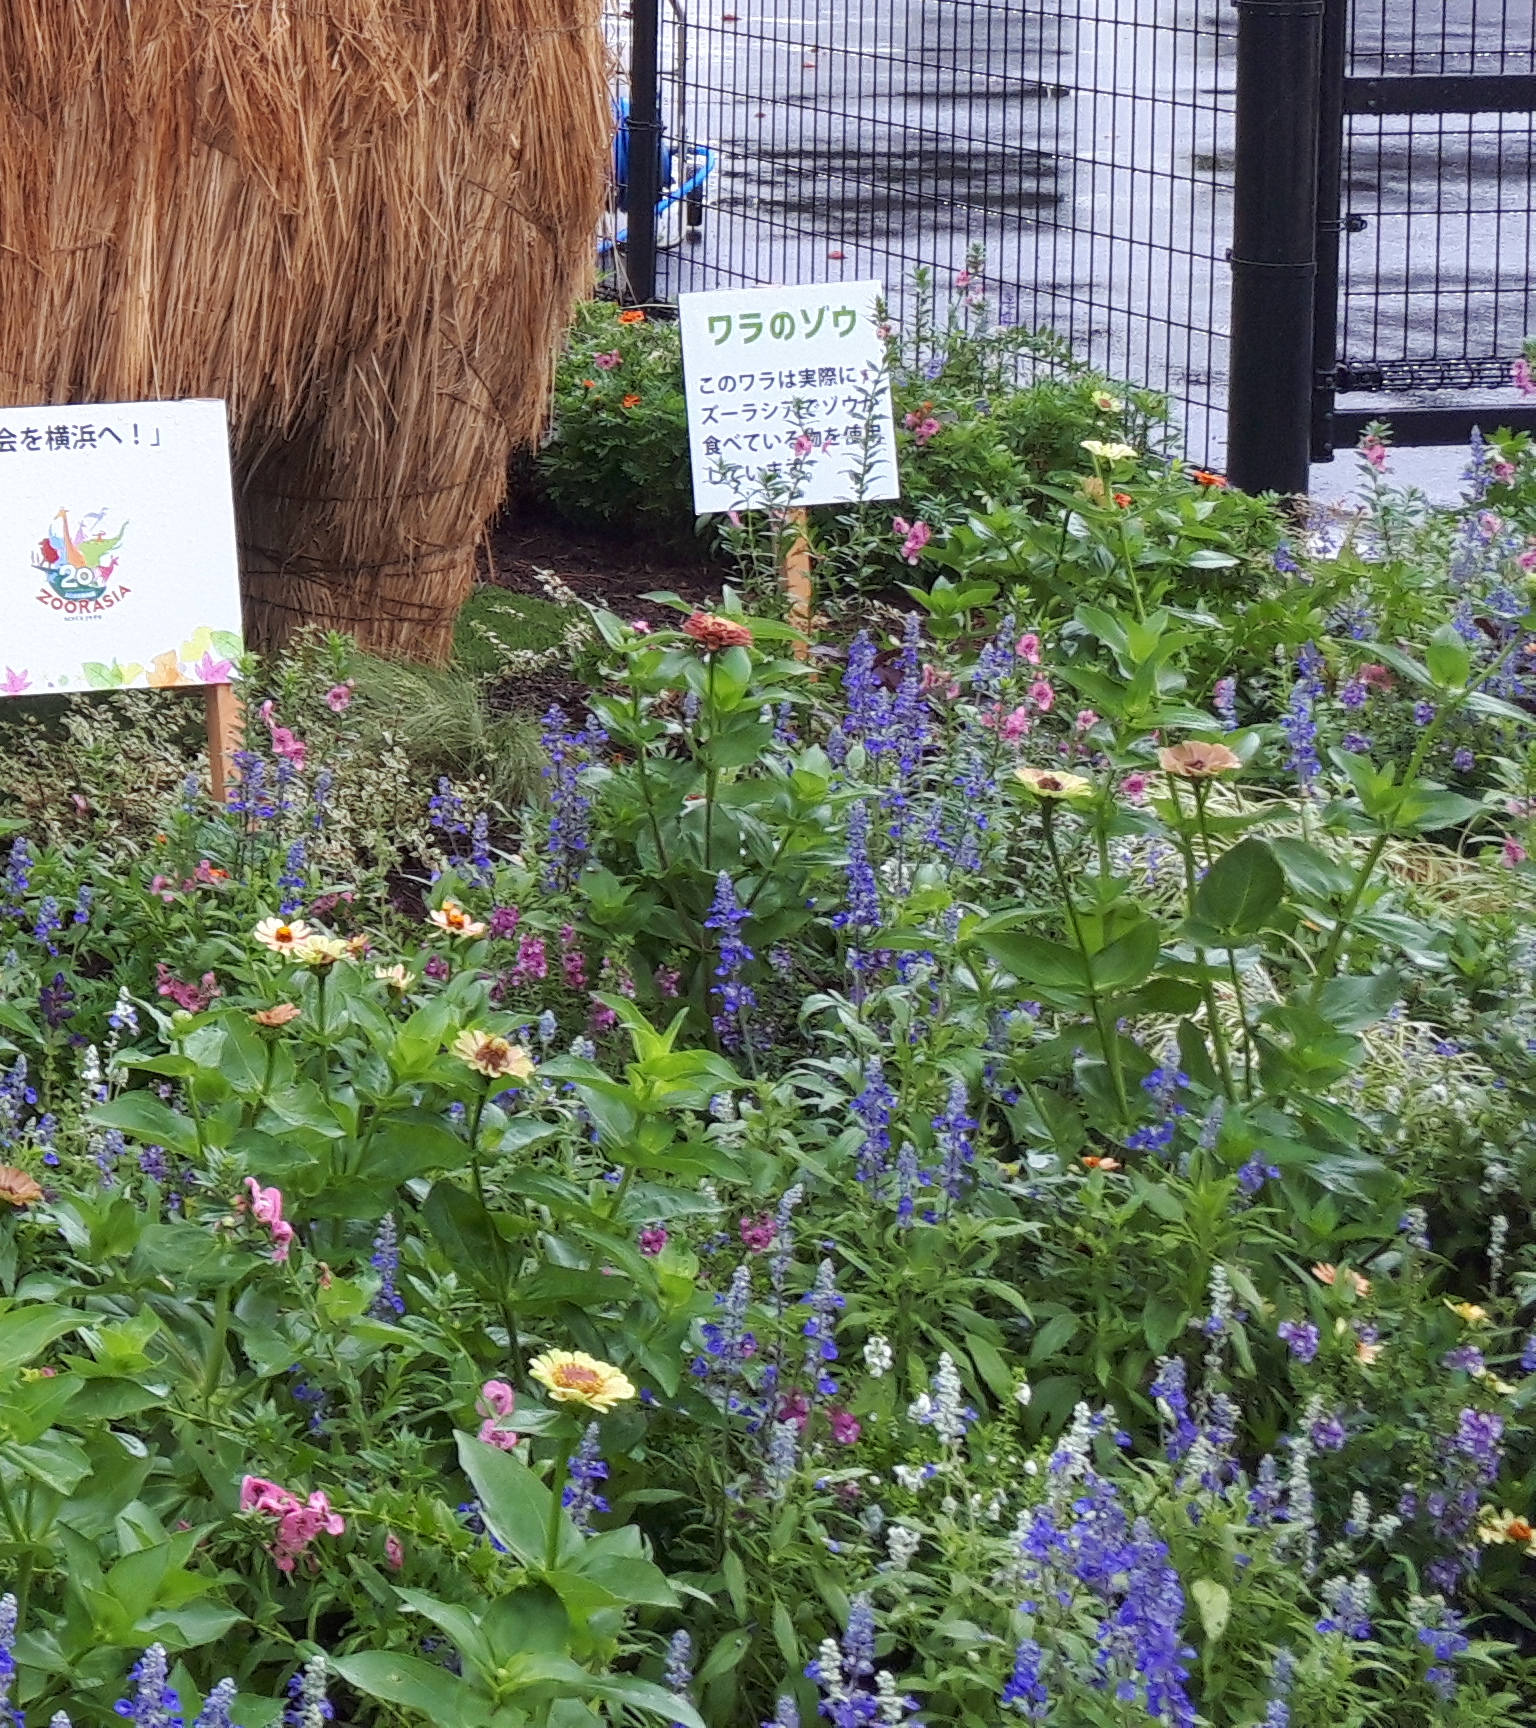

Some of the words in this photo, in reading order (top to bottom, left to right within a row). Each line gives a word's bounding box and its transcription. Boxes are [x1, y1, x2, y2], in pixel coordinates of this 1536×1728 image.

[708, 305, 857, 346] ワラのゾウ
[698, 366, 857, 395] このワラは実際に
[59, 563, 94, 588] 20
[34, 584, 132, 615] ZOORASIA
